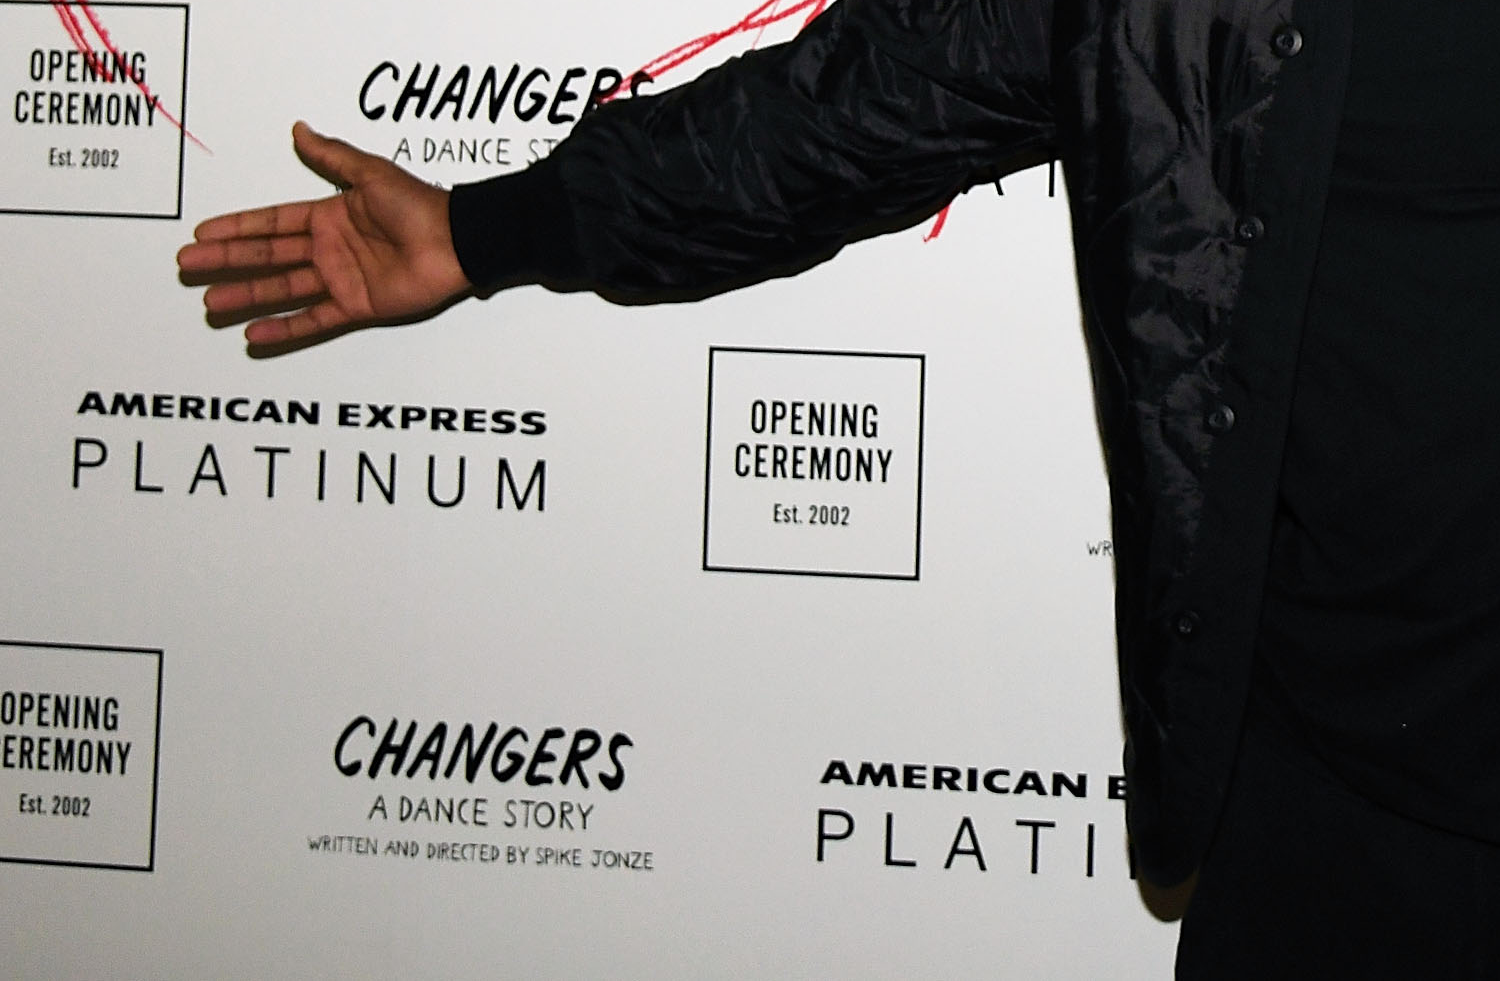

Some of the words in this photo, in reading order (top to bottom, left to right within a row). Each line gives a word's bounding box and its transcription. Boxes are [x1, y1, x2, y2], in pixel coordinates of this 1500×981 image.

[31, 49, 145, 85] OPENING
[15, 91, 158, 126] CEREMONY
[48, 147, 76, 167] Est.
[81, 148, 119, 170] 2002
[393, 137, 412, 163] A
[424, 138, 510, 165] DANCE
[77, 392, 319, 425] AMERICAN
[338, 403, 546, 435] EXPRESS
[752, 400, 877, 438] OPENING
[73, 438, 545, 511] PLATINUM
[735, 443, 892, 482] CEREMONY
[773, 503, 803, 524] Est.
[809, 505, 850, 527] 2002
[1, 692, 118, 731] OPENING
[0, 734, 132, 776] EREMONY
[335, 716, 633, 791] CHANGERS
[820, 760, 1087, 798] AMERICAN
[19, 793, 47, 815] Est.
[51, 795, 91, 818] 2002
[369, 796, 387, 819] A
[400, 796, 487, 826] DANCE
[504, 800, 593, 829] STORY
[308, 835, 378, 855] WRITTEN
[383, 841, 419, 859] AND
[426, 842, 500, 863] DIRECTED
[505, 846, 530, 865] BY
[536, 847, 582, 868] SPIKE
[590, 850, 654, 871] JONZE
[815, 808, 1137, 880] PLATI
